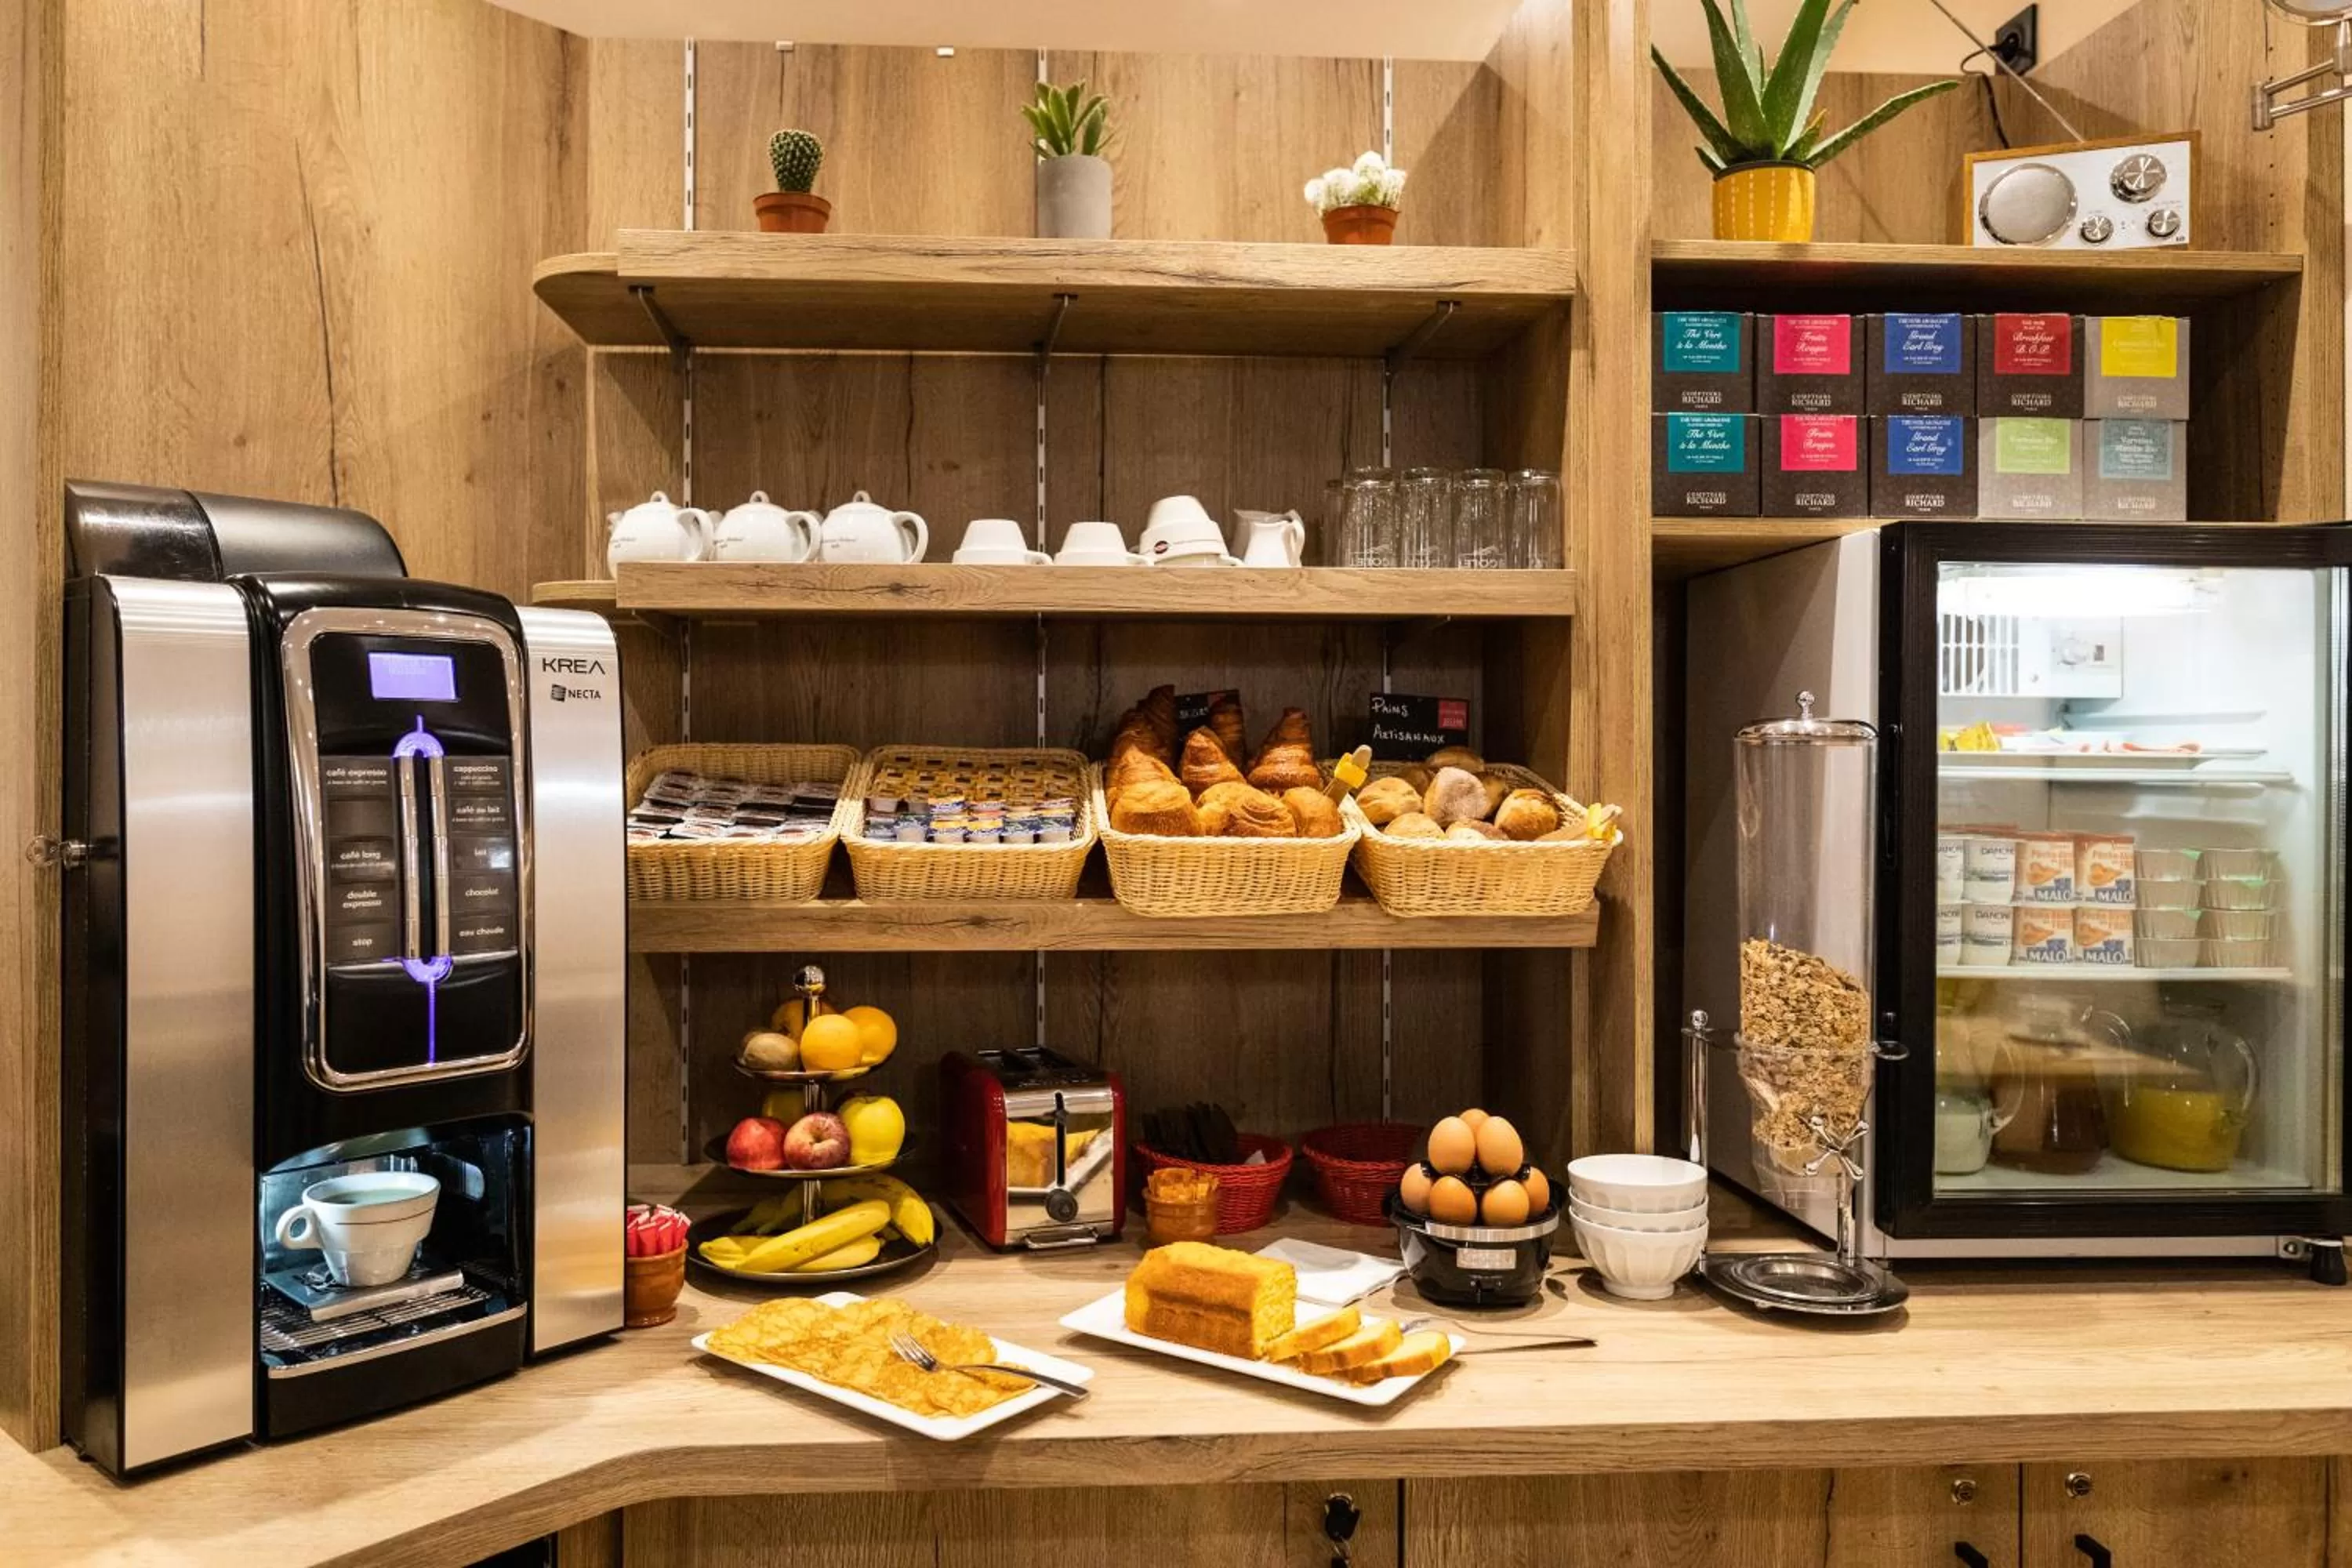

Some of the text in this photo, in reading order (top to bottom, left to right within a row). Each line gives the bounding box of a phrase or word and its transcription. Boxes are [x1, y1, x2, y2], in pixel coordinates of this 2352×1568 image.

[1903, 341, 1924, 350] Earl
[1906, 443, 1927, 452] Earl
[543, 658, 606, 675] KREA
[568, 689, 601, 699] NECTA
[326, 768, 387, 778] café expresso
[456, 805, 474, 814] café
[339, 851, 381, 860] café long
[347, 891, 377, 899] double
[465, 887, 499, 897] chocolat
[2037, 890, 2071, 902] MALO
[2096, 891, 2132, 902] MALO
[343, 899, 382, 909] expresso
[476, 927, 505, 935] chaude
[352, 938, 373, 947] stop
[2028, 949, 2067, 962] MALO
[2085, 950, 2124, 964] MALO
